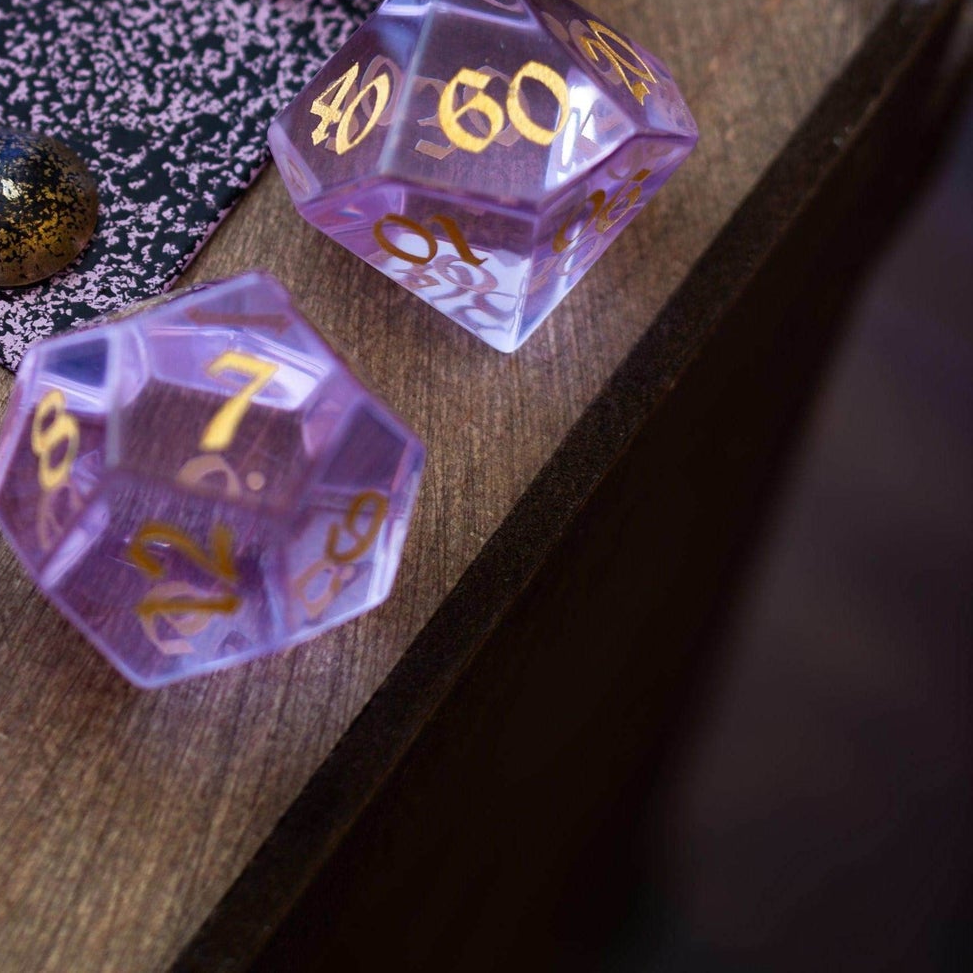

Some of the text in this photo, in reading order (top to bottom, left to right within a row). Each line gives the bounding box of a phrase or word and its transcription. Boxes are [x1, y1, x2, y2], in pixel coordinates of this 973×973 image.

[309, 61, 391, 156] 40
[438, 59, 570, 154] 60
[30, 388, 80, 490] 8
[199, 348, 280, 452] 7
